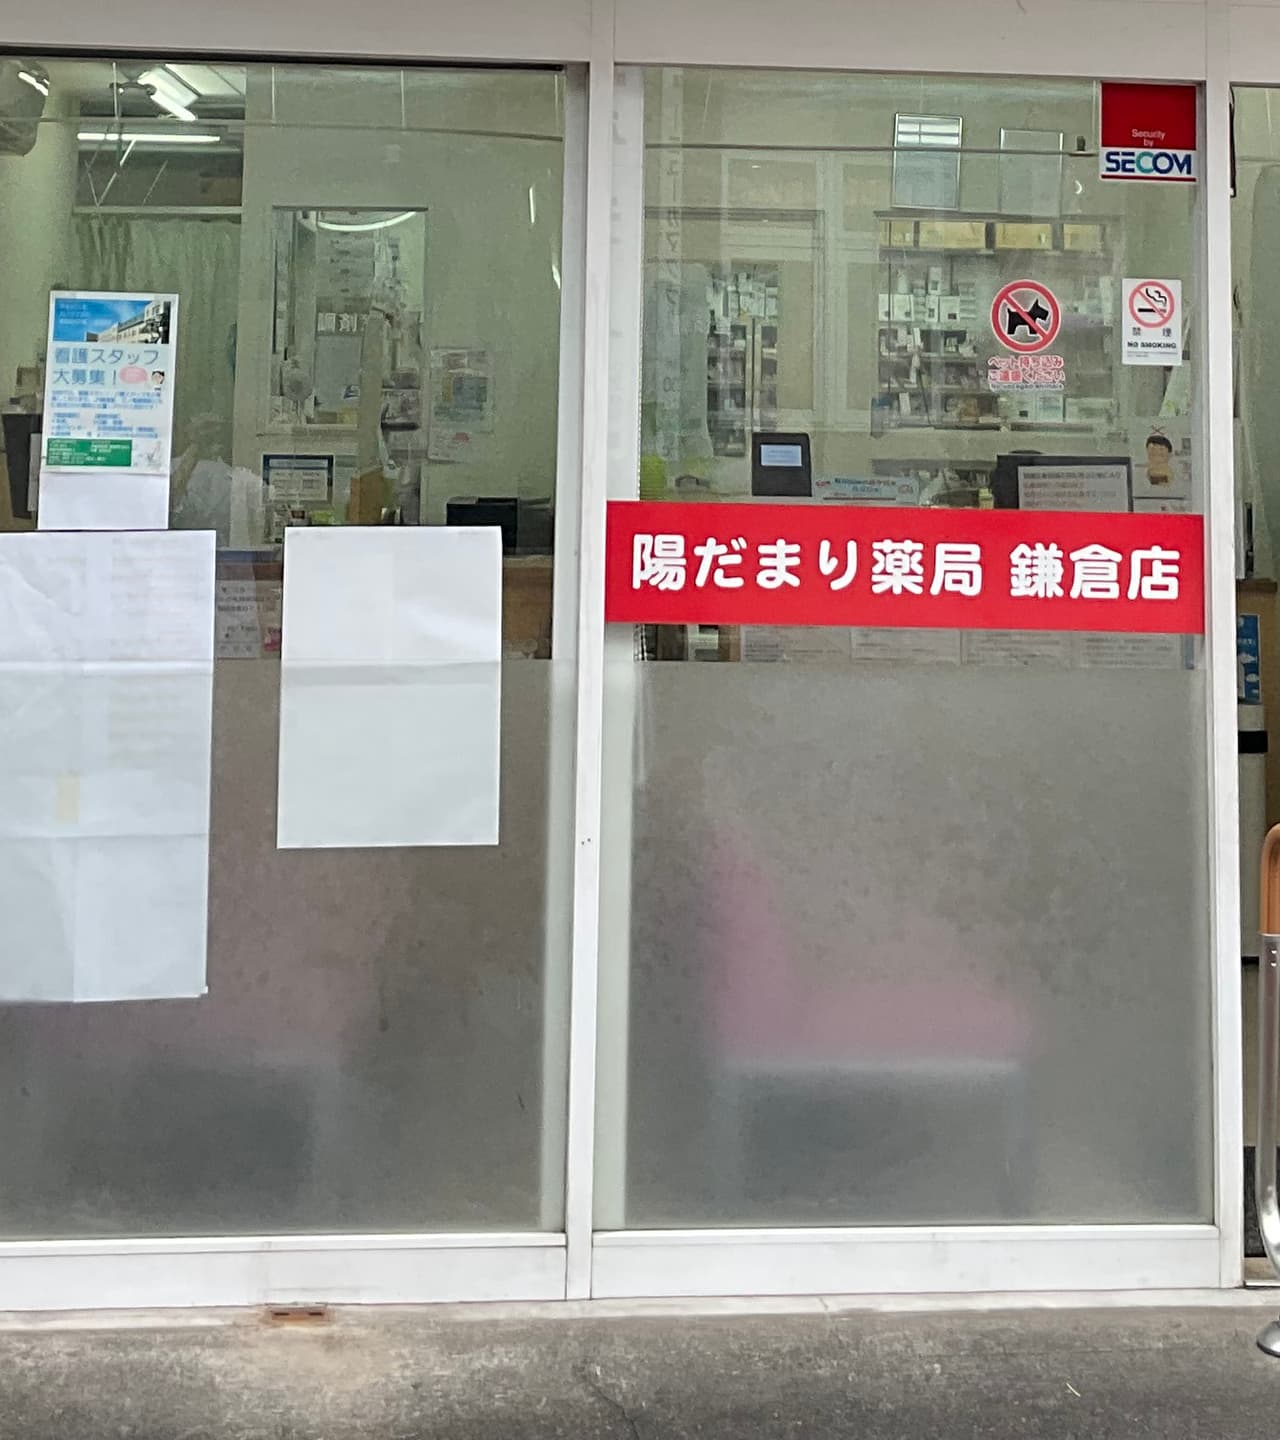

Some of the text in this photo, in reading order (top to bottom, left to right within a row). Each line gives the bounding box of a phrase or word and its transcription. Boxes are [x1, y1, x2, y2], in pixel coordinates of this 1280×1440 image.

[1131, 128, 1166, 141] Security
[1143, 138, 1155, 147] by
[1105, 150, 1192, 175] SECOM
[632, 533, 1181, 601] 陽だまり薬局 鎌倉店
